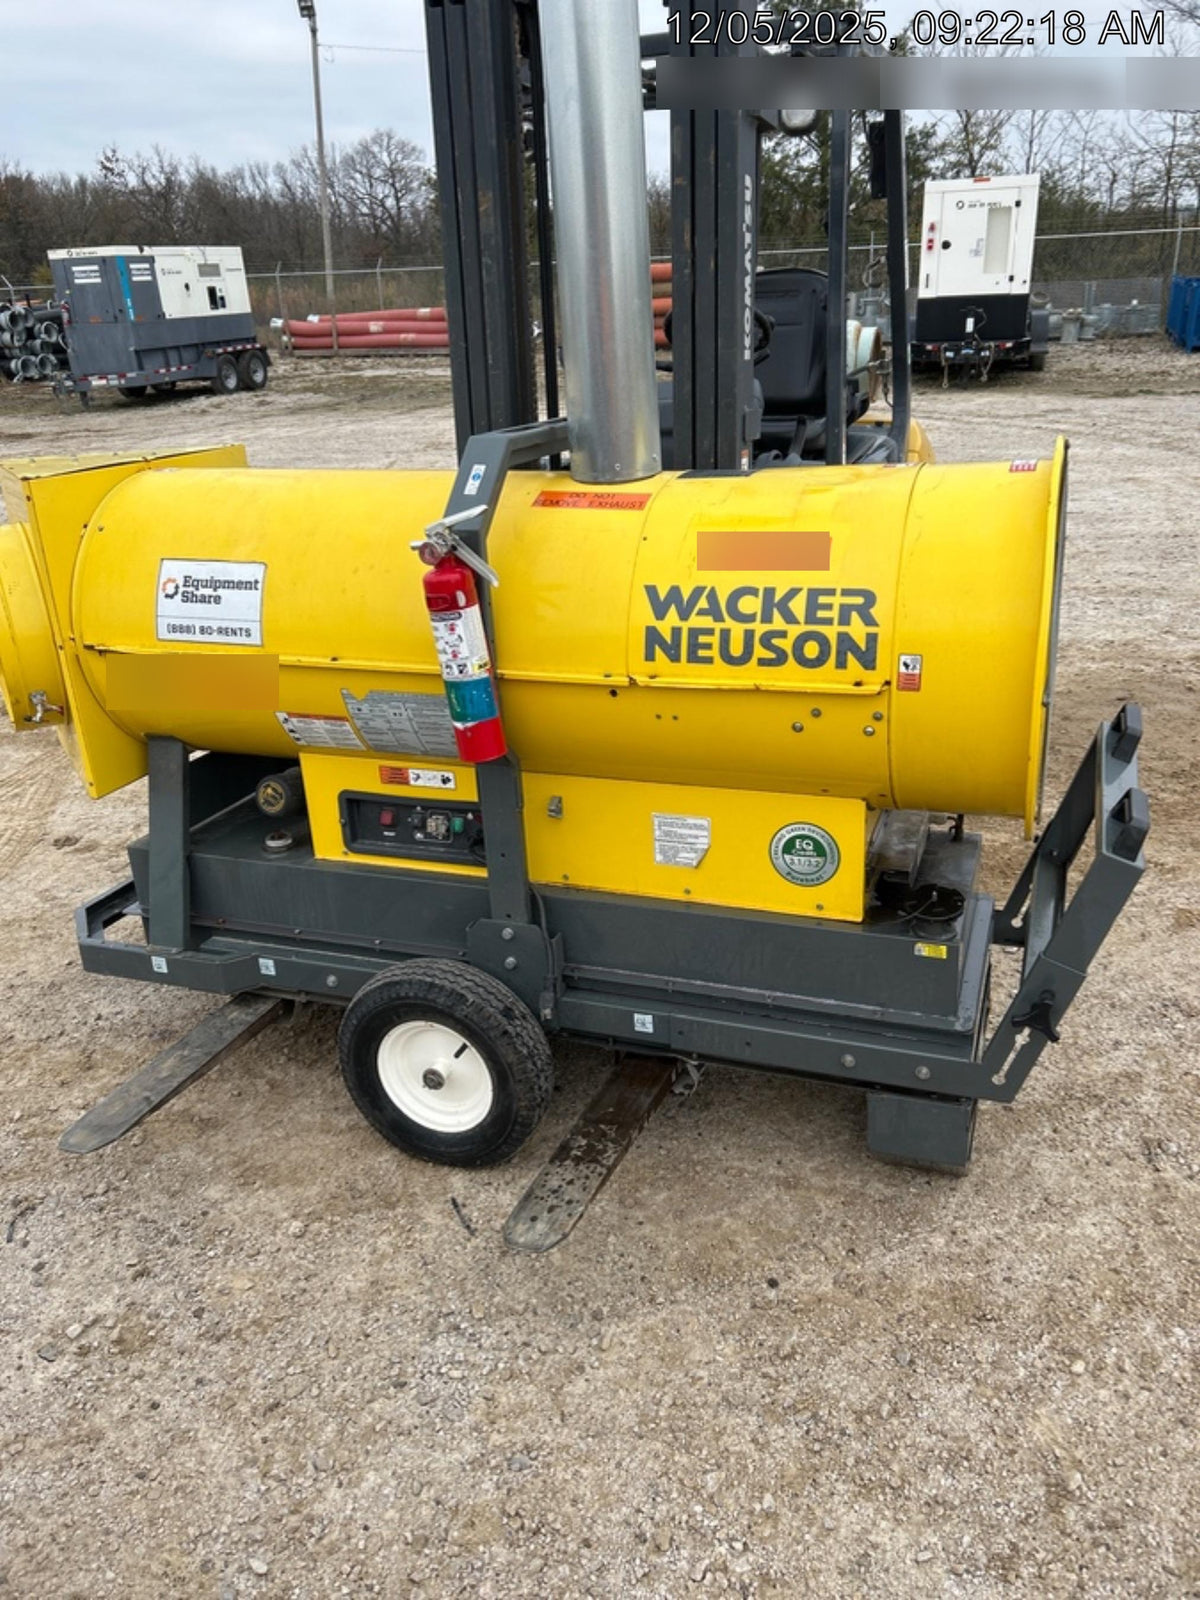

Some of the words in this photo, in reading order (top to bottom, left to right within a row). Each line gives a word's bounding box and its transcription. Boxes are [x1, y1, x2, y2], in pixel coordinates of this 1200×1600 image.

[742, 173, 753, 361] KOMATSU
[587, 501, 644, 509] EXHAUST
[182, 575, 260, 592] Equipment
[180, 590, 222, 605] Share
[643, 584, 880, 627] WACKER
[166, 623, 197, 635] (888)
[198, 625, 252, 638] 80-RENTS
[643, 625, 879, 671] NEUSON
